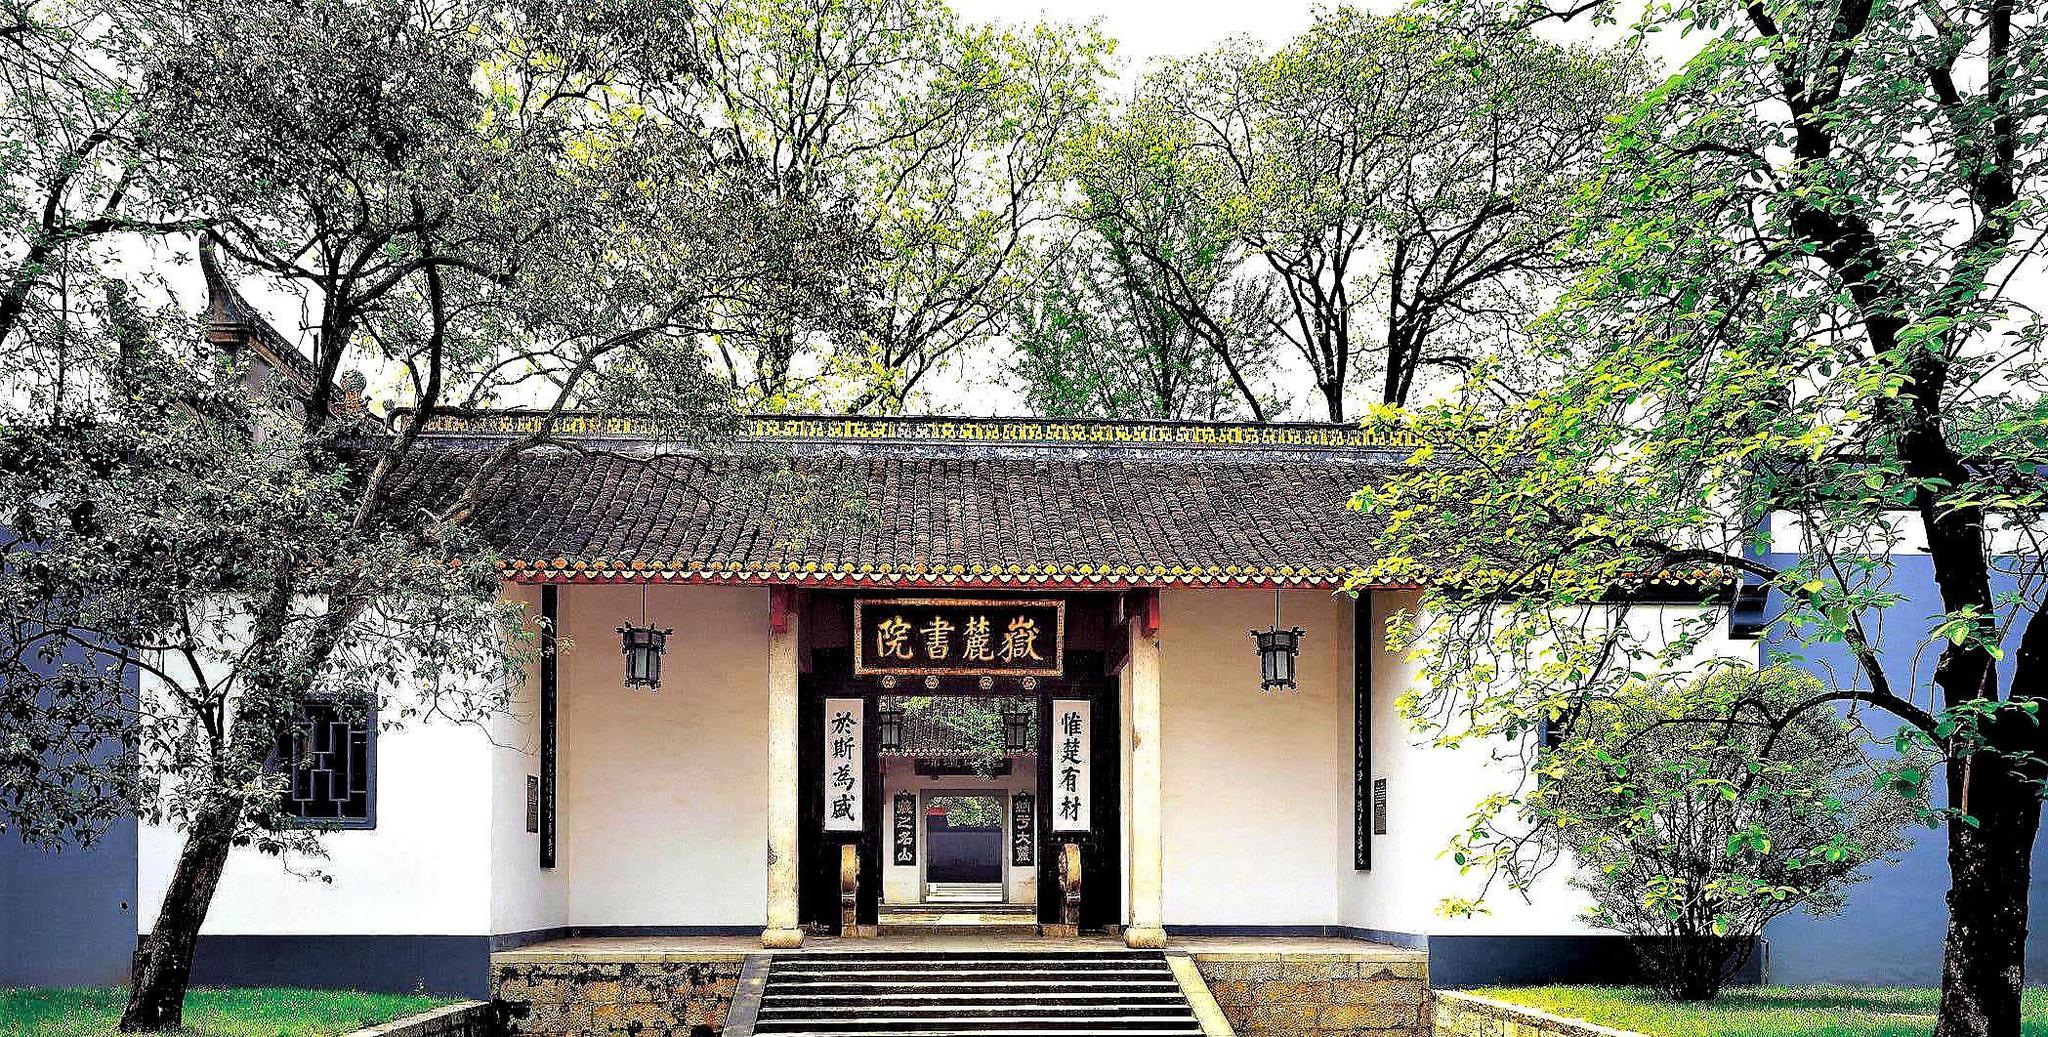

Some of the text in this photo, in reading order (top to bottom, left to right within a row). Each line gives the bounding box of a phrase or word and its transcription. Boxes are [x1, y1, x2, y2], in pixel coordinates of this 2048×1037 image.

[876, 615, 1044, 663] 嶽麓書院
[1060, 712, 1082, 822] 惟楚有材
